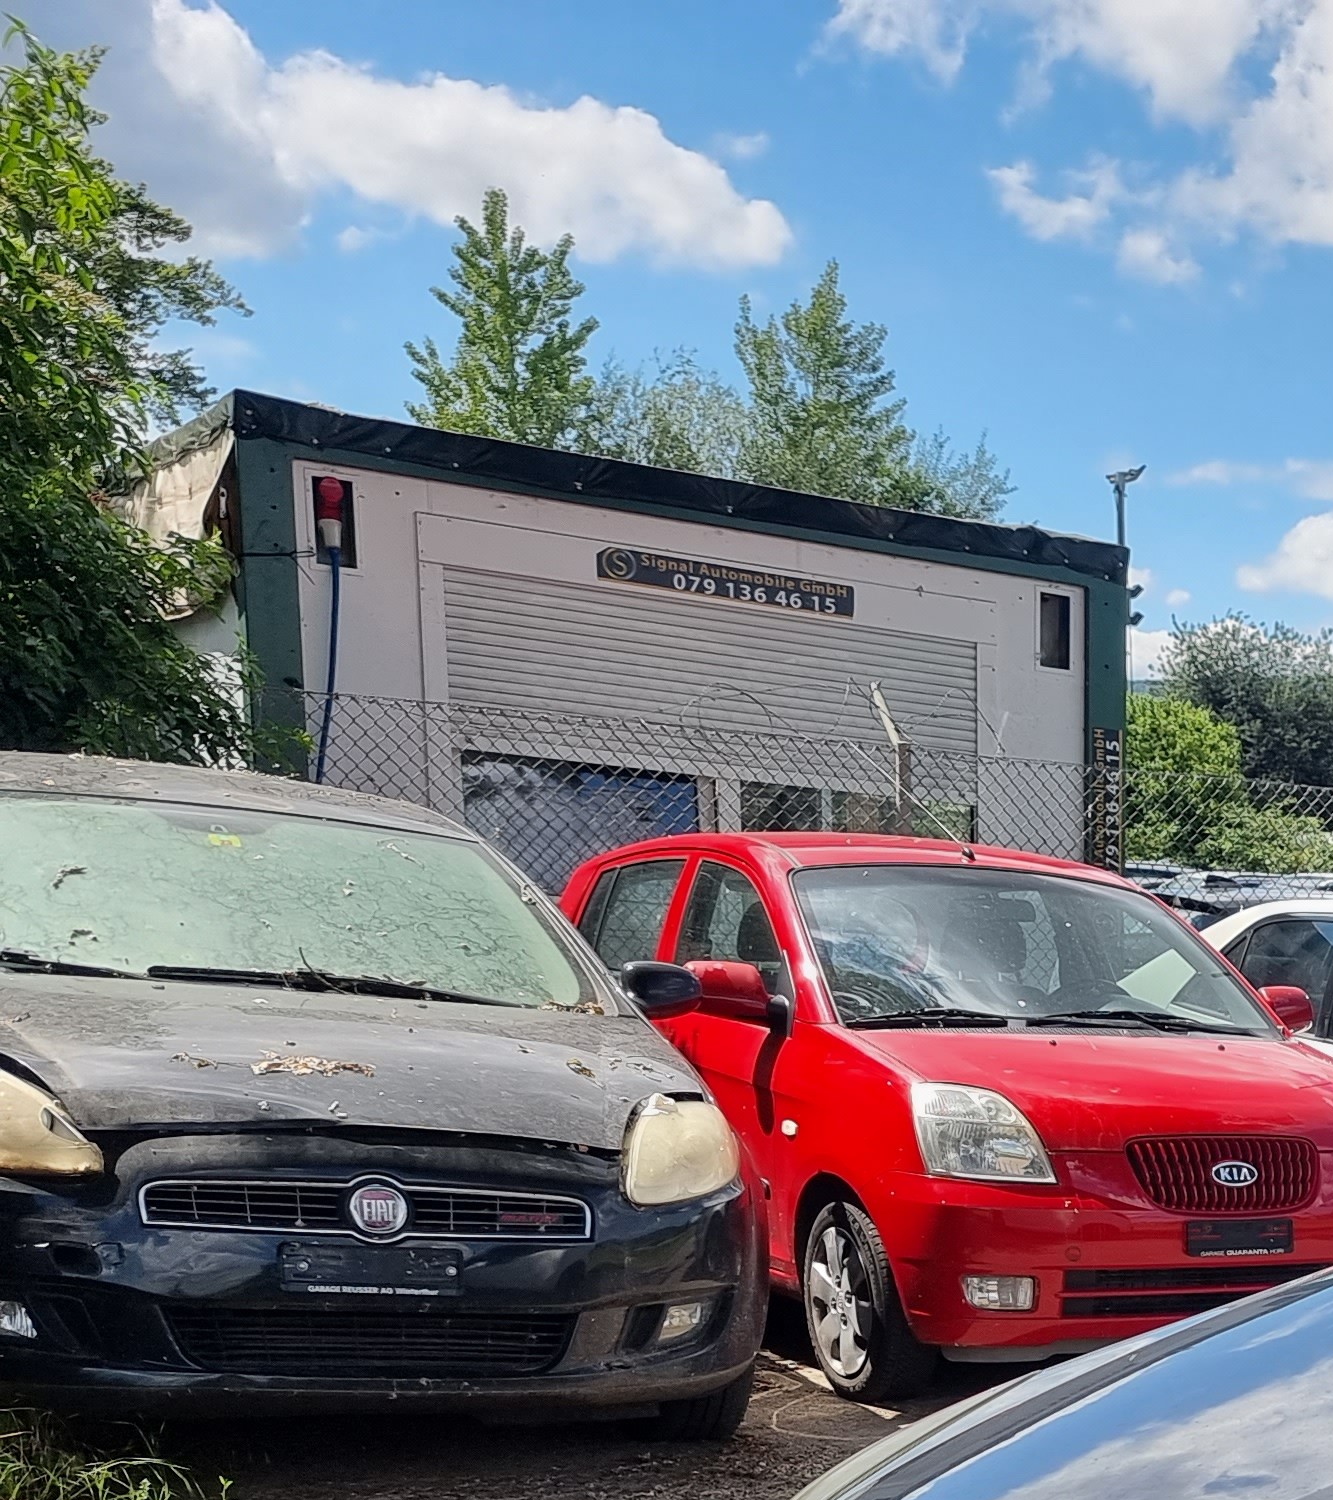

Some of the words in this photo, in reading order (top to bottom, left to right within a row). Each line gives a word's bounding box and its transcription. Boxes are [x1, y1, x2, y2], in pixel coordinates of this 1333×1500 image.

[640, 554, 694, 572] Signal
[700, 563, 796, 590] Automobile
[800, 580, 848, 598] GmbH
[673, 573, 716, 595] 079
[726, 582, 767, 603] 136
[774, 590, 803, 609] 46
[811, 595, 836, 613] 15
[1093, 728, 1105, 770] GmbH
[1105, 740, 1120, 762] 15
[1105, 771, 1120, 796] 46
[1105, 800, 1120, 837] 136
[1105, 845, 1120, 873] 79
[1219, 1167, 1252, 1181] KIA
[362, 1199, 396, 1222] FIAT
[1226, 1248, 1269, 1256] QUARANTA
[307, 1285, 341, 1293] GARAGE
